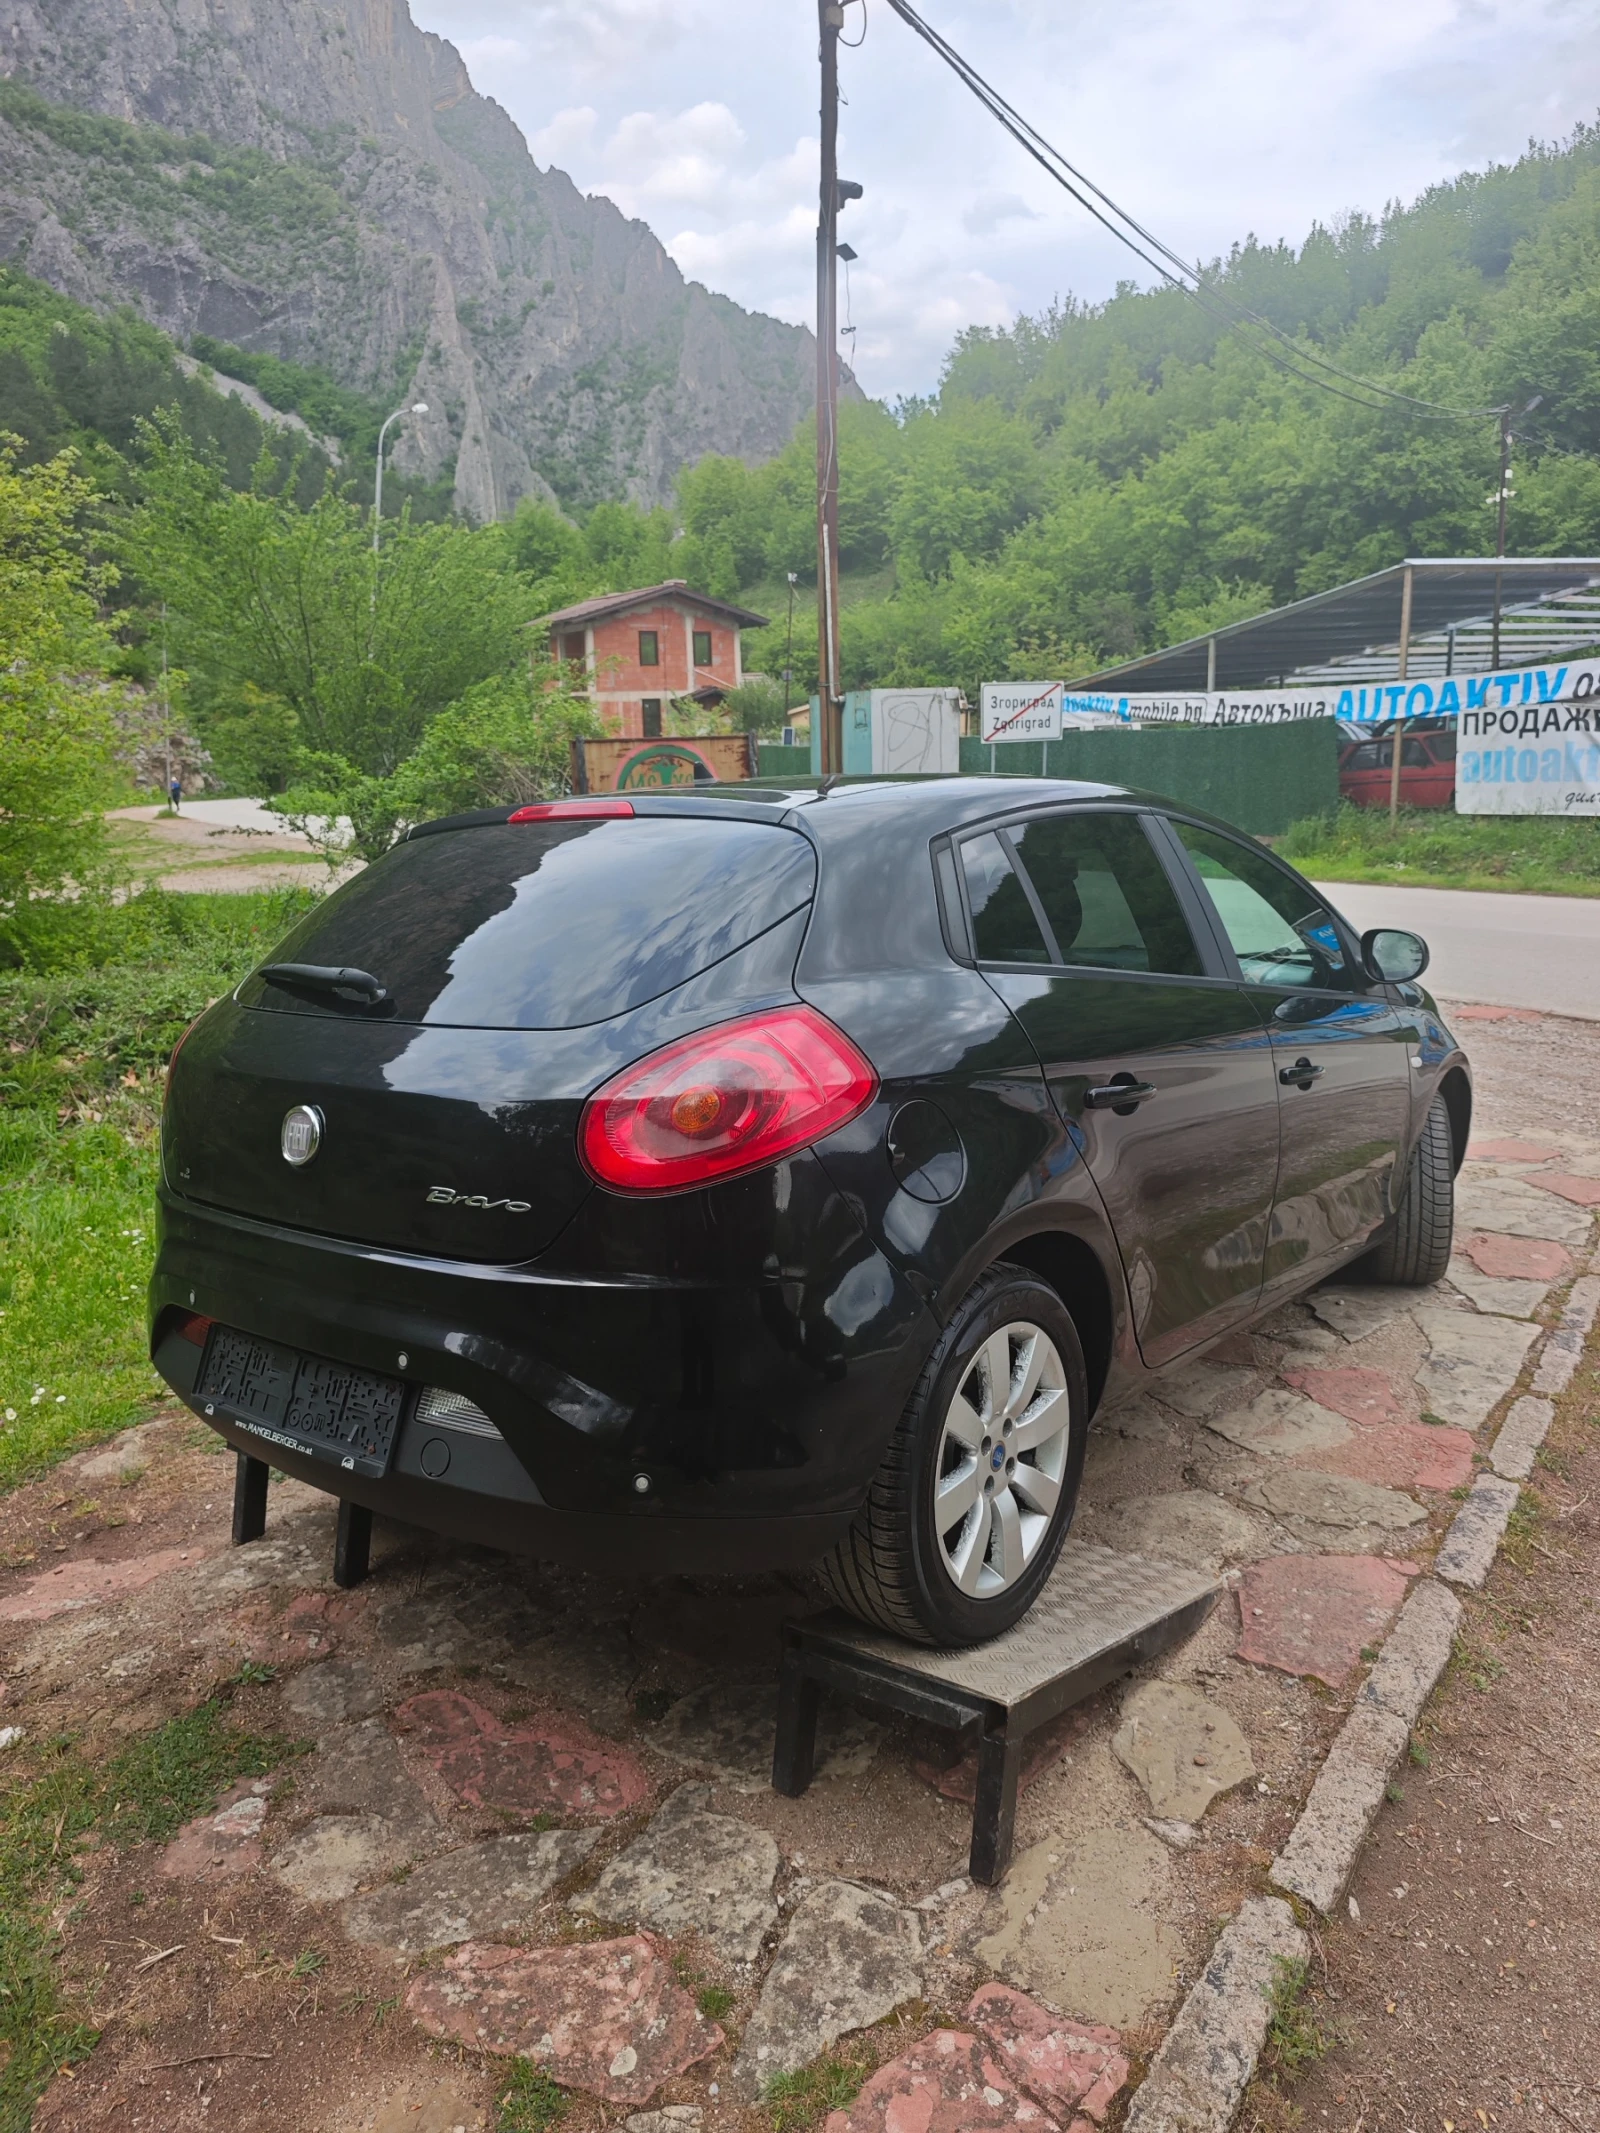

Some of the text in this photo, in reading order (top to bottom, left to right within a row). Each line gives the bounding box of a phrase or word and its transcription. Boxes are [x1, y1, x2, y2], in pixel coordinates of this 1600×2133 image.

[990, 696, 1054, 711] Згориград
[1335, 667, 1568, 722] AUTOAKTIV
[993, 715, 1051, 733] Zgorigrad
[1129, 702, 1203, 724] mobile.bg
[287, 1122, 311, 1151] FIAT
[426, 1186, 532, 1212] Bravo
[235, 1420, 313, 1456] www.MANGELBERGER.co.at
